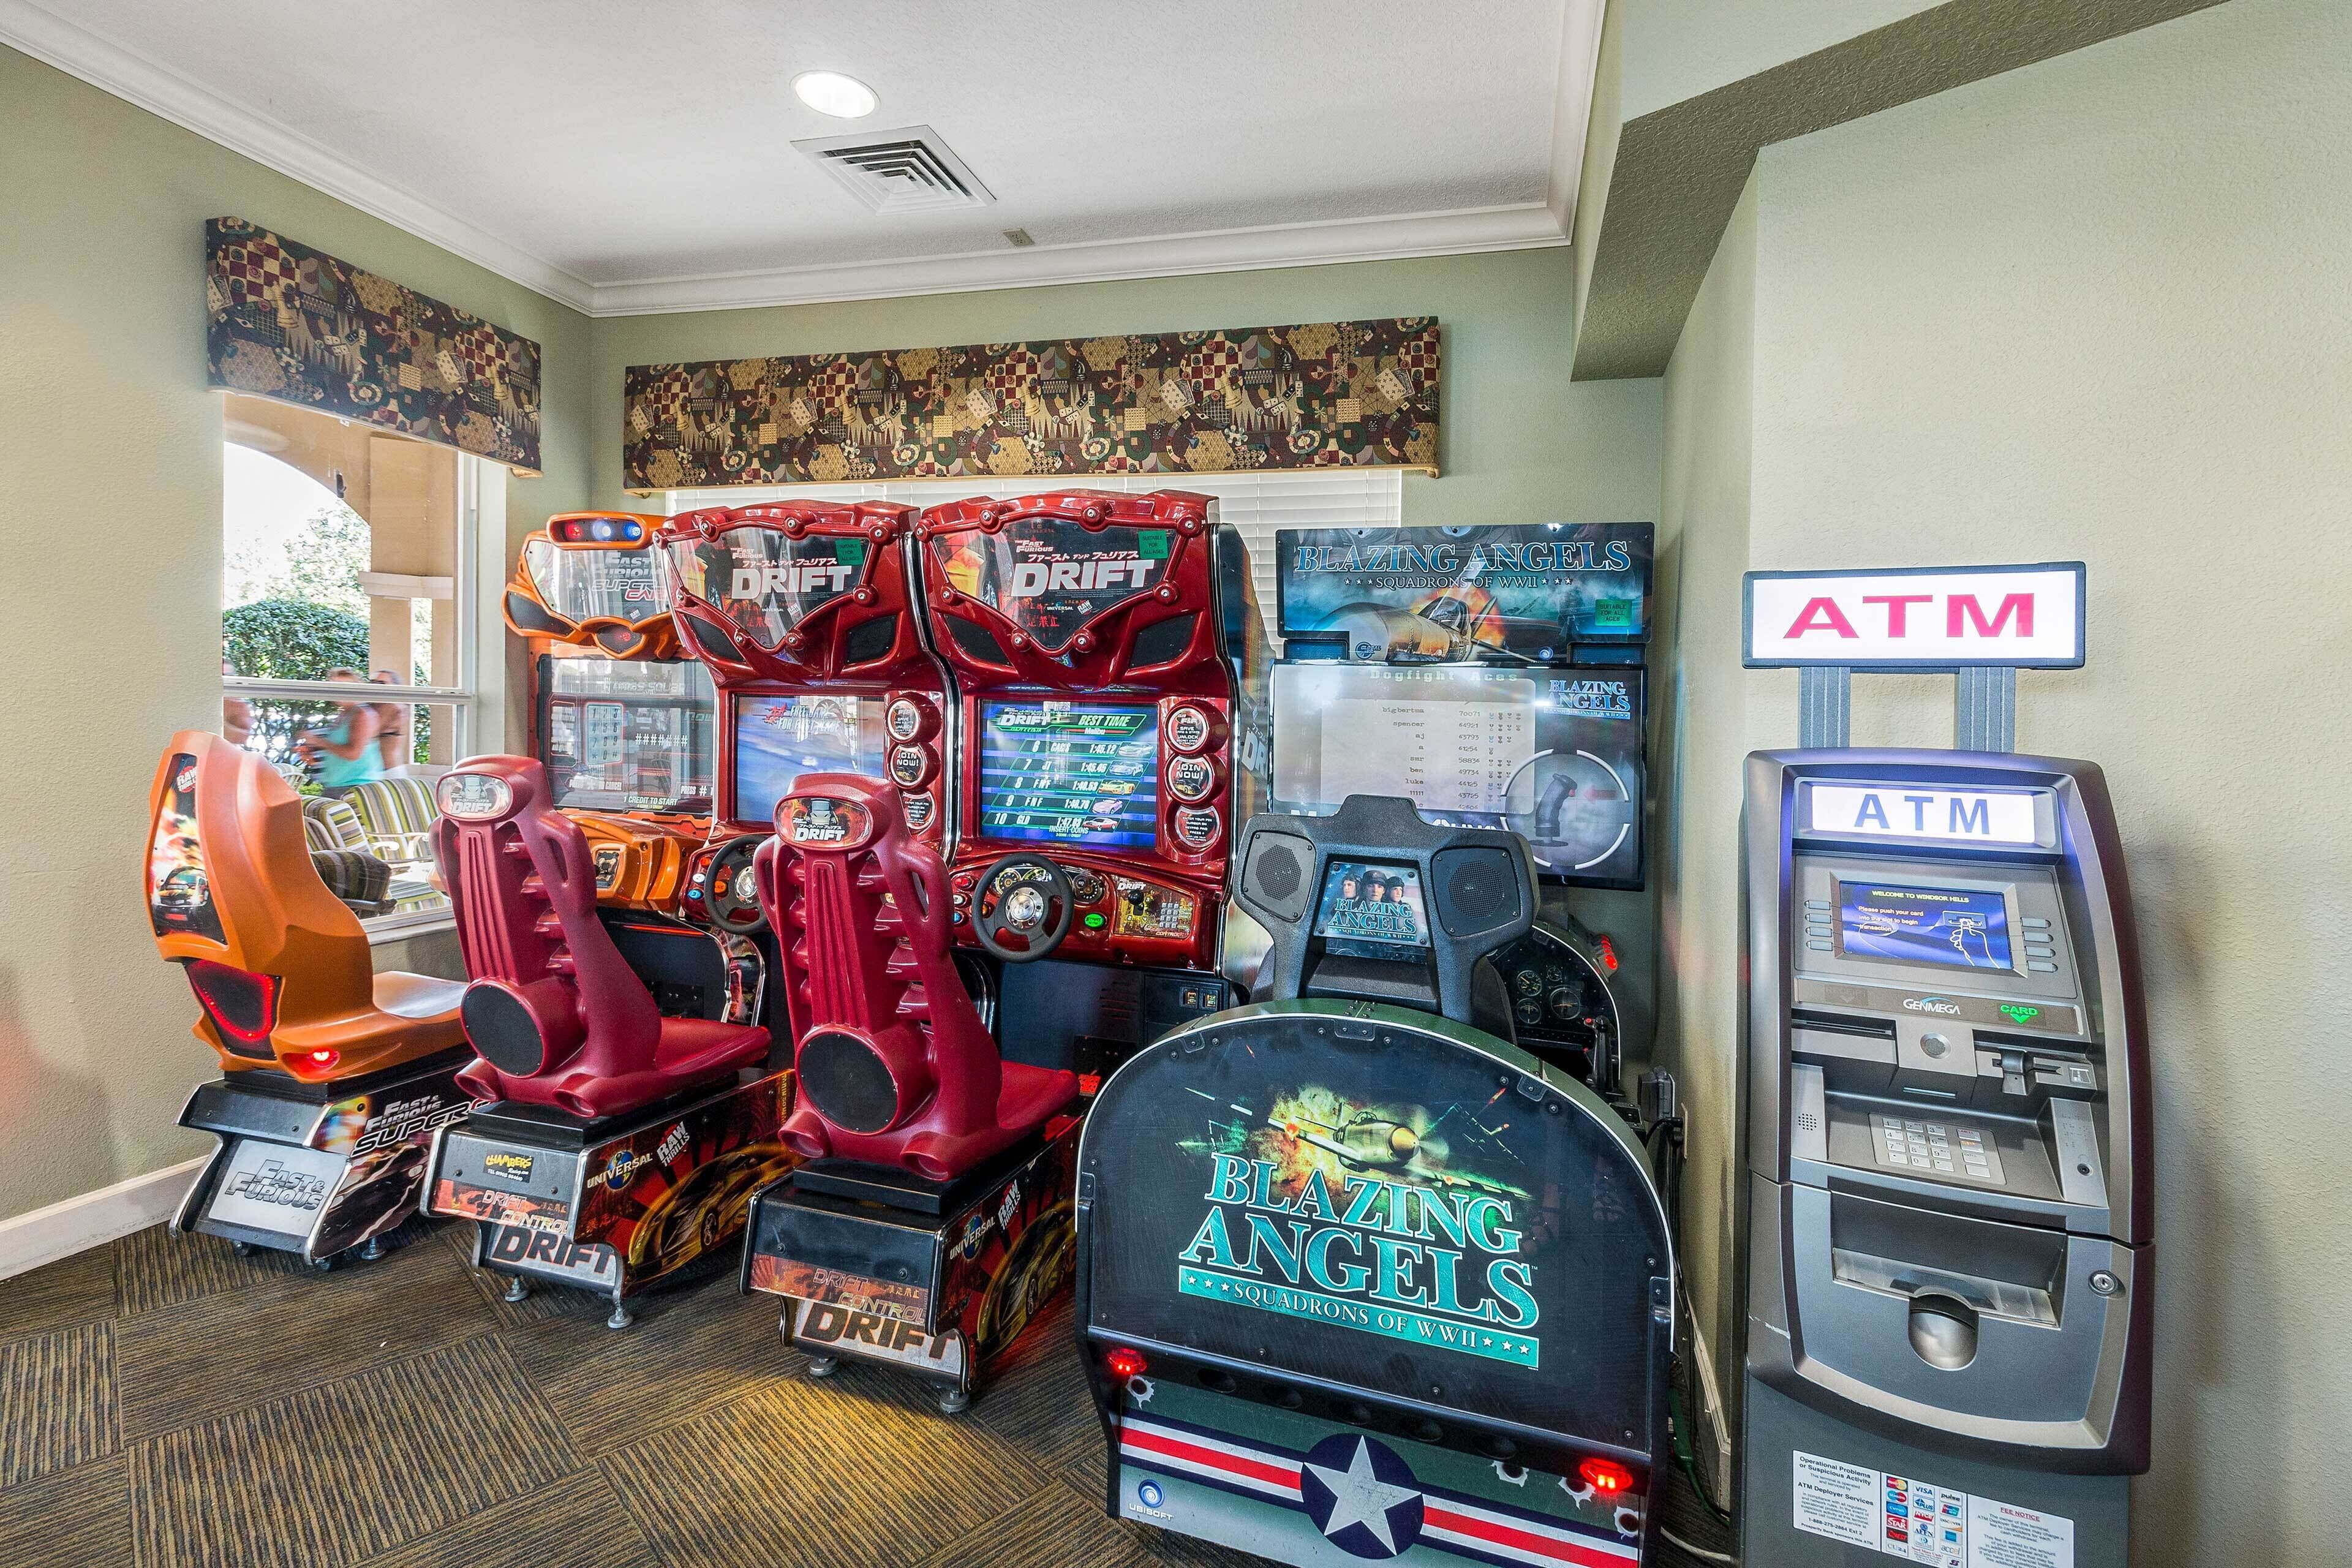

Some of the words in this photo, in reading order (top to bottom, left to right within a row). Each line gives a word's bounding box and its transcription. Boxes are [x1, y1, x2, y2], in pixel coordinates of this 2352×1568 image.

[1295, 543, 1459, 573] BLAZING
[1463, 540, 1632, 572] ANGELS
[731, 566, 852, 599] DRIFT
[1011, 559, 1155, 597] DRIFT
[1376, 576, 1468, 590] SQUADRONS
[1476, 576, 1493, 588] OF
[1501, 576, 1538, 588] WWII
[1783, 592, 2034, 638] ATM
[1370, 670, 1455, 682] Dogfight
[1470, 672, 1518, 681] Aces
[1548, 679, 1627, 695] BLAZING
[1548, 692, 1630, 712] ANGELS
[1000, 714, 1050, 726] DRIFT
[1078, 715, 1105, 726] BEST
[1105, 715, 1131, 726] TIME
[1023, 758, 1032, 770] 7
[1014, 777, 1023, 788] 8
[1176, 771, 1203, 780] NOW!
[680, 785, 696, 794] PRESS
[451, 802, 492, 814] DRIFT
[1006, 795, 1014, 807] 9
[1025, 797, 1043, 807] FNF
[994, 813, 1008, 824] 10
[1853, 793, 1991, 835] ATM
[794, 827, 845, 842] DRIFT
[1117, 882, 1146, 891] DRIFT
[1335, 898, 1412, 918] BLAZING
[1328, 911, 1417, 934] ANGELS
[1902, 997, 1960, 1014] GENMEGA
[2000, 1005, 2039, 1016] CARD
[364, 1101, 441, 1134] FURIOUS
[383, 1096, 430, 1119] FAST
[350, 1101, 470, 1158] SUPER
[657, 1121, 687, 1161] RAW
[662, 1131, 690, 1167] THRILLS
[252, 1159, 316, 1191] FAST
[311, 1180, 325, 1193] &
[587, 1153, 653, 1188] UNIVERSAL
[225, 1171, 324, 1210] FURIOUS
[482, 1189, 527, 1210] DRIFT
[998, 1179, 1019, 1224] RAW
[1001, 1191, 1021, 1231] THRILLS
[1204, 1152, 1523, 1254] BLAZING
[501, 1210, 568, 1233] CONTROL
[494, 1224, 617, 1274] DRIFT
[950, 1216, 996, 1260] UNIVERSAL
[1178, 1205, 1539, 1329] ANGELS
[813, 1268, 869, 1292] DRIFT
[837, 1292, 925, 1324] CONTROL
[1234, 1283, 1369, 1326] SQUADRONS
[1378, 1313, 1408, 1333] OF
[1415, 1319, 1477, 1349] WWII
[801, 1300, 957, 1360] DRIFT
[1800, 1456, 1838, 1470] Operational
[1839, 1466, 1871, 1479] Problems
[1808, 1464, 1844, 1479] Suspicious
[1846, 1474, 1871, 1486] Activity
[1814, 1485, 1844, 1498] Deployer
[1845, 1494, 1874, 1506] Services
[1915, 1486, 1933, 1495] VISA
[1128, 1502, 1174, 1521] UBISOFT
[2015, 1510, 2040, 1522] NOTICE
[1887, 1520, 1906, 1529] STAR
[1941, 1545, 1960, 1555] accel
